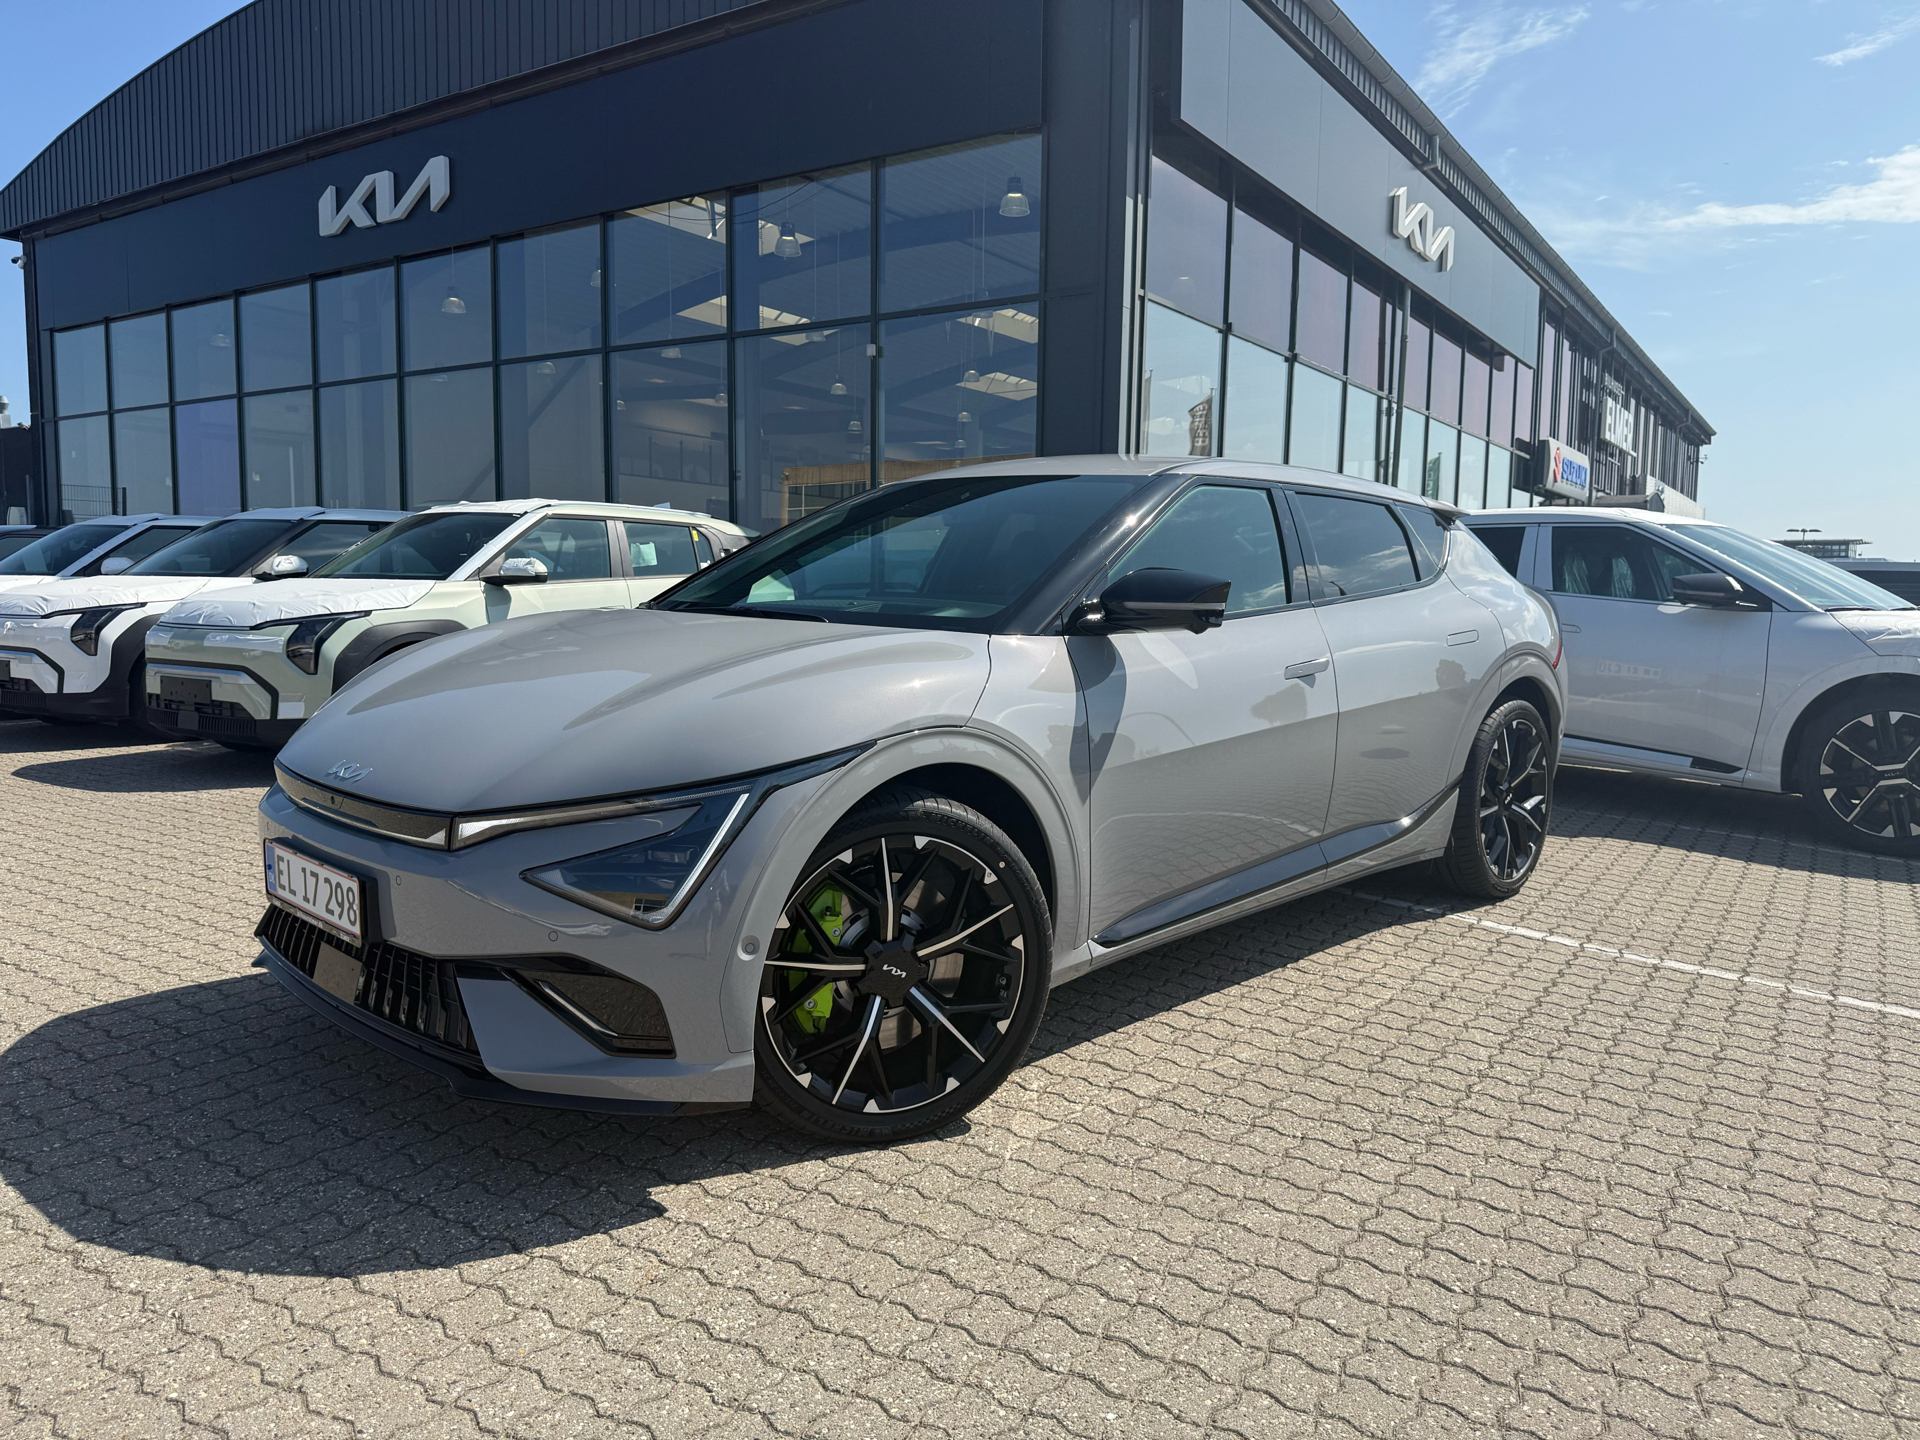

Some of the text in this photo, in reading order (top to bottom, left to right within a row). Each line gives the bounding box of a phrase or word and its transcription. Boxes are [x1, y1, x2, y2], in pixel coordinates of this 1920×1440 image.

[318, 155, 450, 237] KIA
[1390, 186, 1455, 272] KIA
[1561, 457, 1588, 488] SUZUKI
[327, 759, 373, 782] KIA
[930, 812, 994, 846] MICHELIN
[276, 854, 297, 897] EL
[301, 867, 319, 907] 17
[323, 877, 358, 927] 298
[882, 963, 907, 979] KIA
[799, 1109, 871, 1137] MICHELIN
